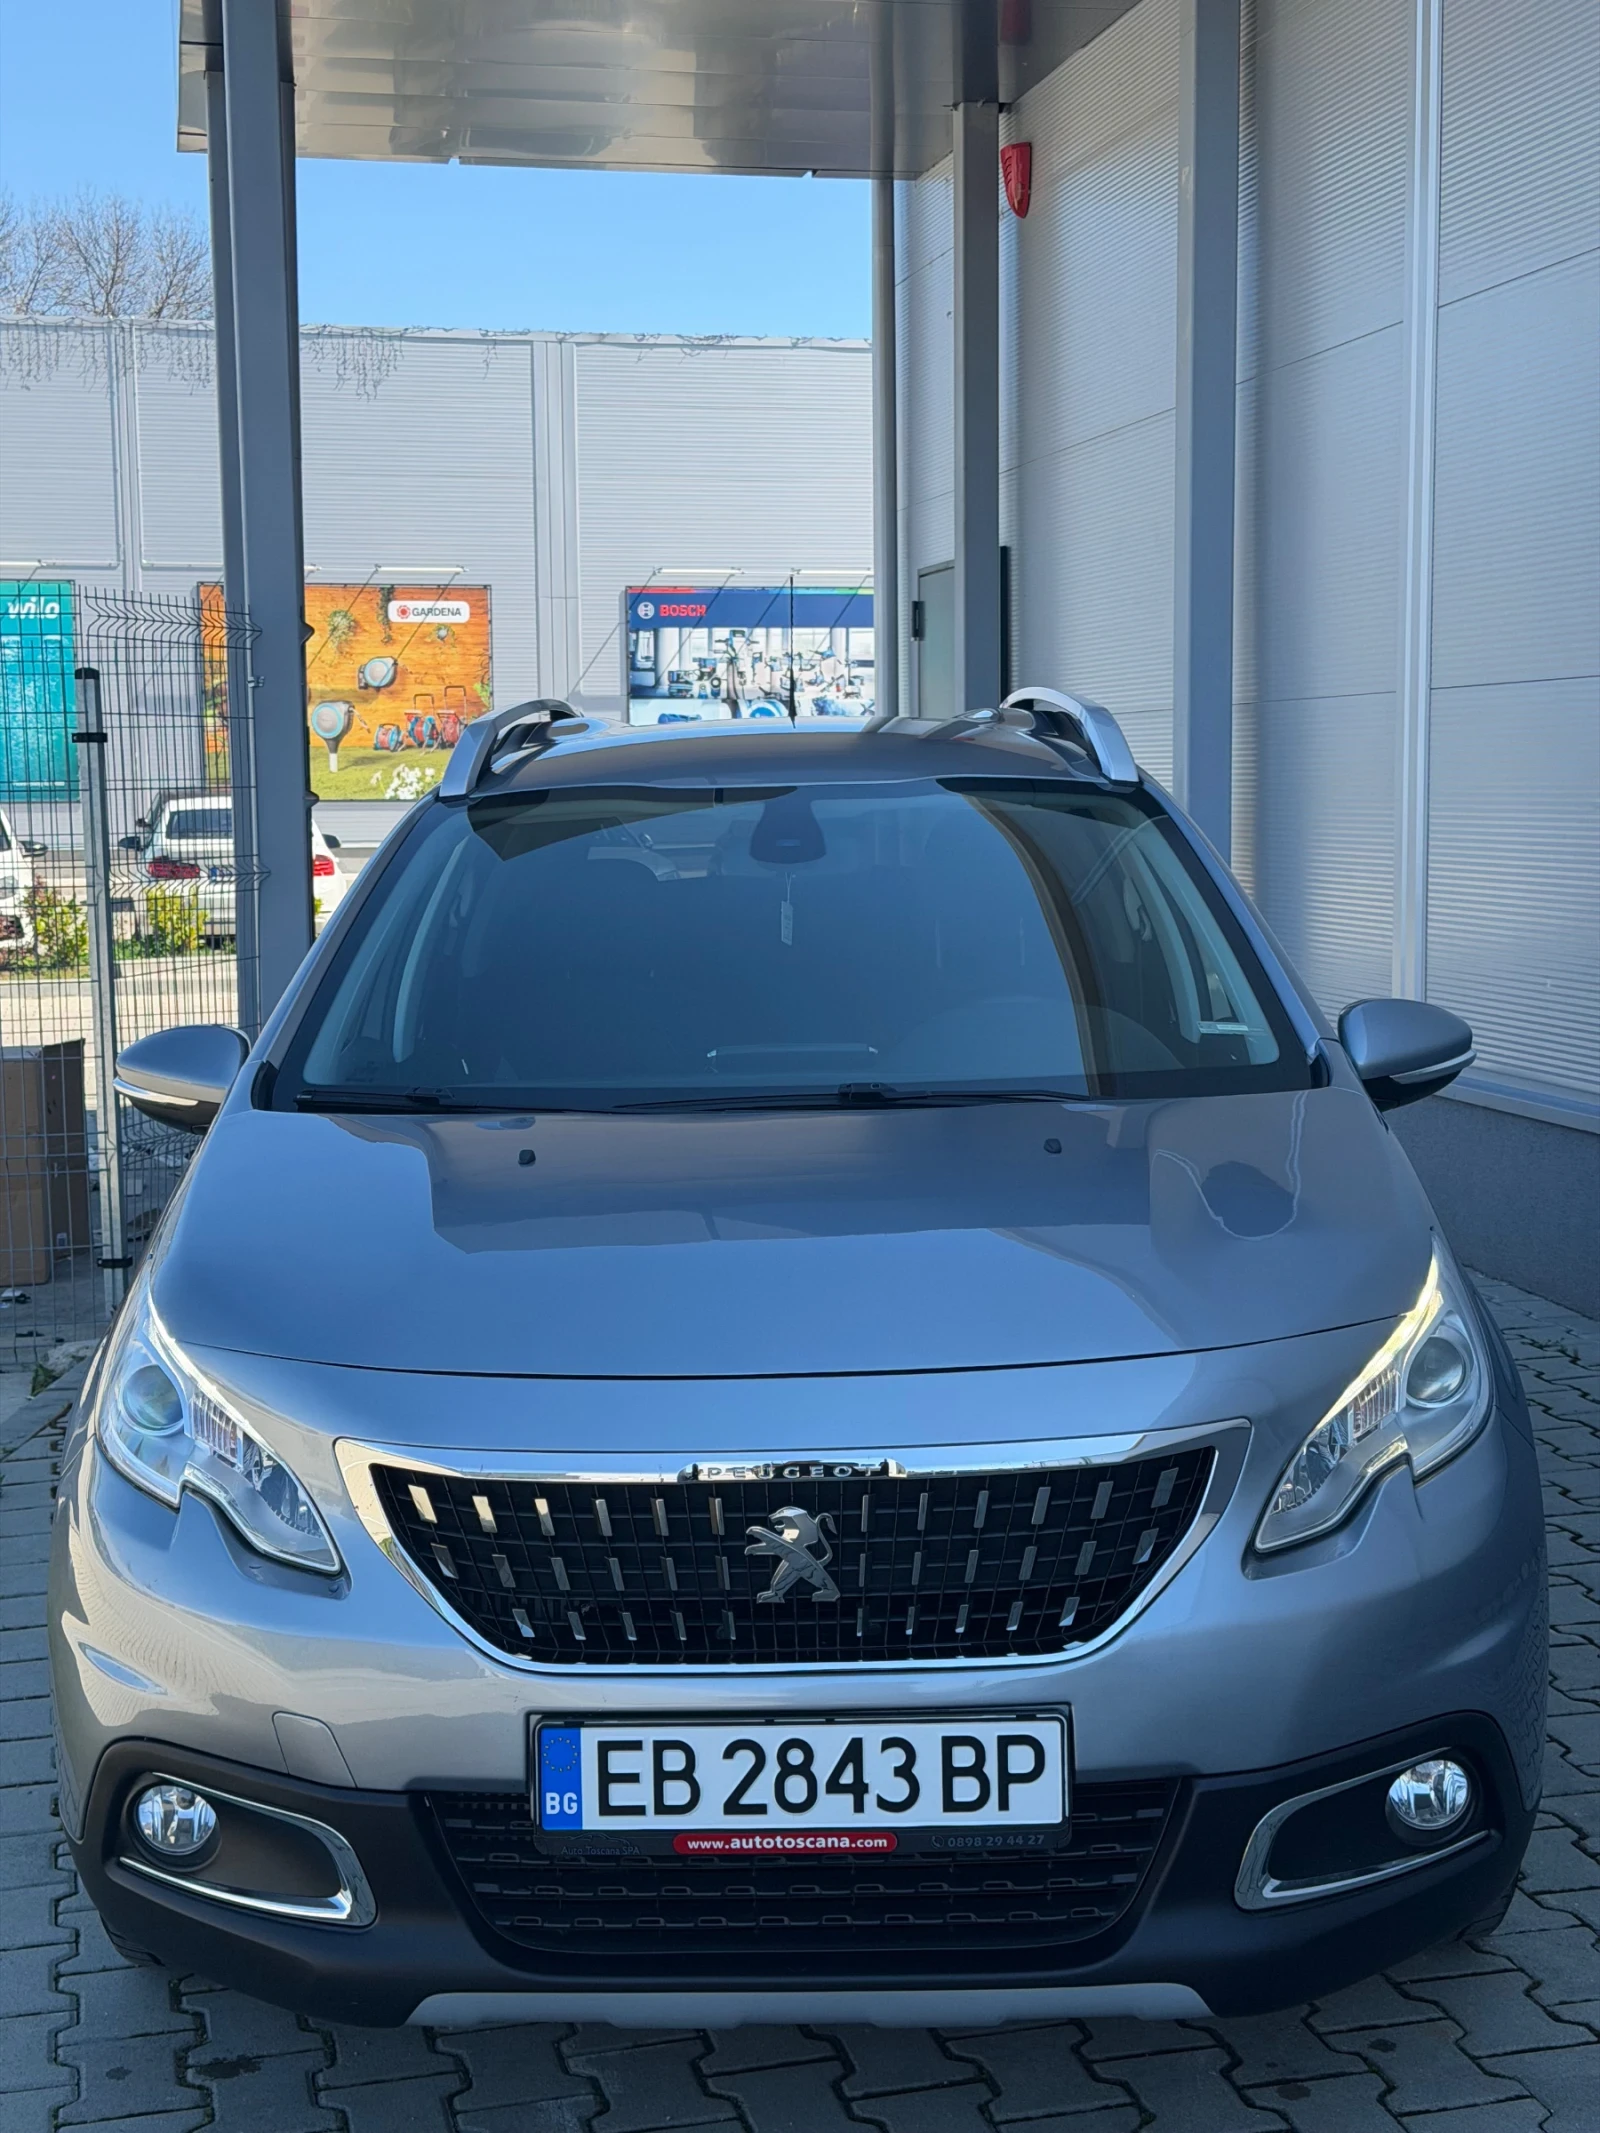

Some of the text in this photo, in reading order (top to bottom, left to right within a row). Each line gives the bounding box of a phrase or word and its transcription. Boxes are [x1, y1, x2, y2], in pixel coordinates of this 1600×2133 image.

[7, 597, 60, 619] wilo
[411, 607, 463, 617] GARDENA
[660, 604, 708, 617] BOSCH
[706, 1463, 881, 1479] PEUGEOT
[597, 1734, 1046, 1816] EB 2843 BP
[545, 1792, 578, 1815] BG
[561, 1845, 640, 1855] Auto Toscana SPA
[687, 1835, 888, 1850] www.autotoscana.com
[947, 1837, 982, 1848] 0898
